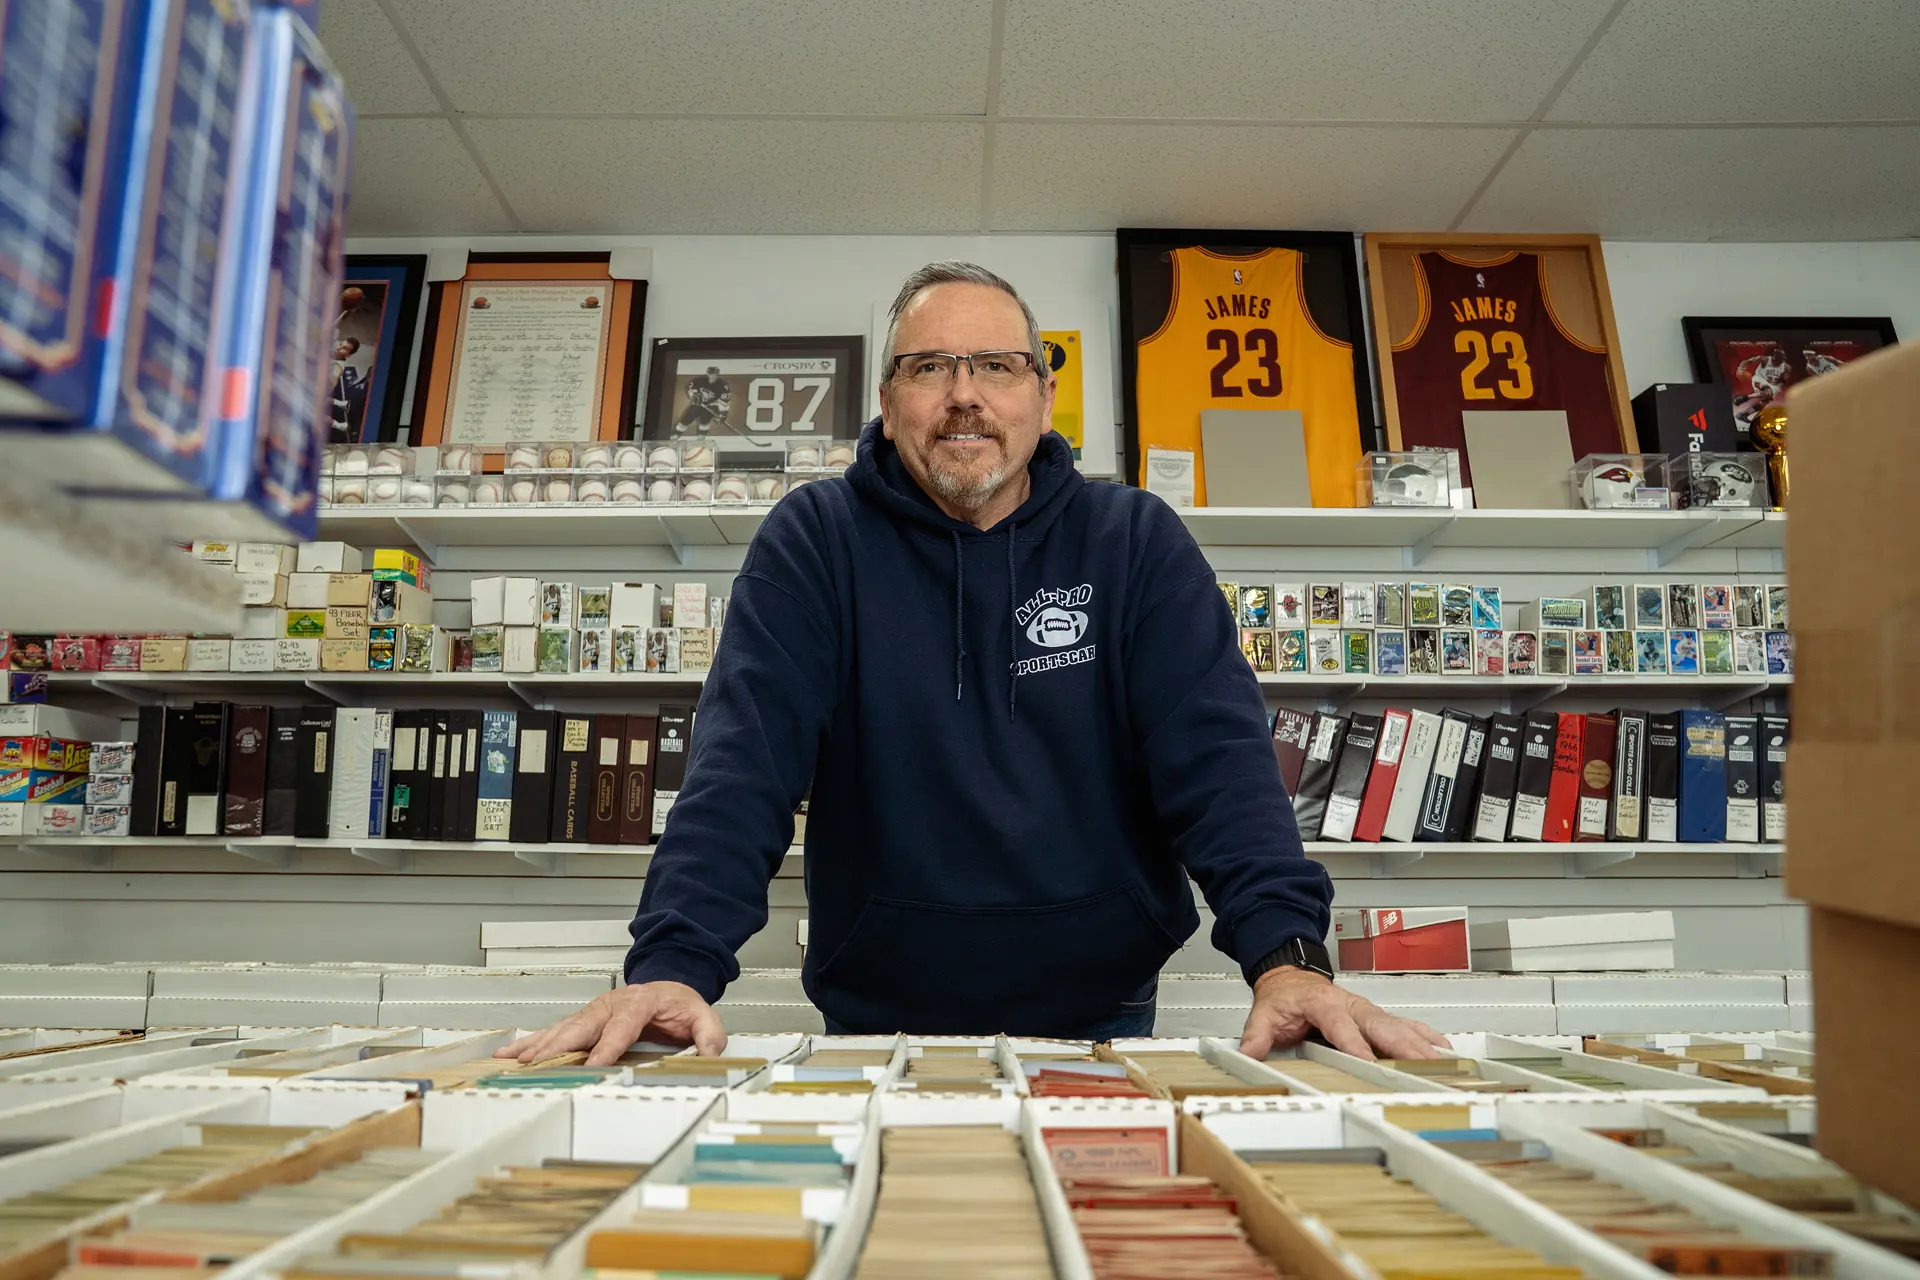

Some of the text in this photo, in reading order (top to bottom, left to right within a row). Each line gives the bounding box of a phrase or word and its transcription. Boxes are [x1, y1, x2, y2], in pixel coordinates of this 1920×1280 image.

[1204, 294, 1271, 320] JAMES
[1450, 297, 1517, 322] JAMES
[1206, 328, 1283, 398] 23
[1454, 330, 1534, 400] 23
[745, 377, 831, 432] 87
[328, 609, 338, 618] 93
[1015, 584, 1092, 626] ALL-PRO
[343, 628, 360, 637] Set
[1010, 644, 1096, 676] PORTSCAR
[484, 713, 516, 722] BASEBALL
[1280, 710, 1311, 725] BASEBALL
[1492, 744, 1514, 756] BASEBALL
[1527, 742, 1549, 753] BASEBALL
[34, 774, 64, 797] Baseball
[1435, 776, 1446, 814] COLLECTION
[566, 761, 578, 839] BASEBALL CARDS
